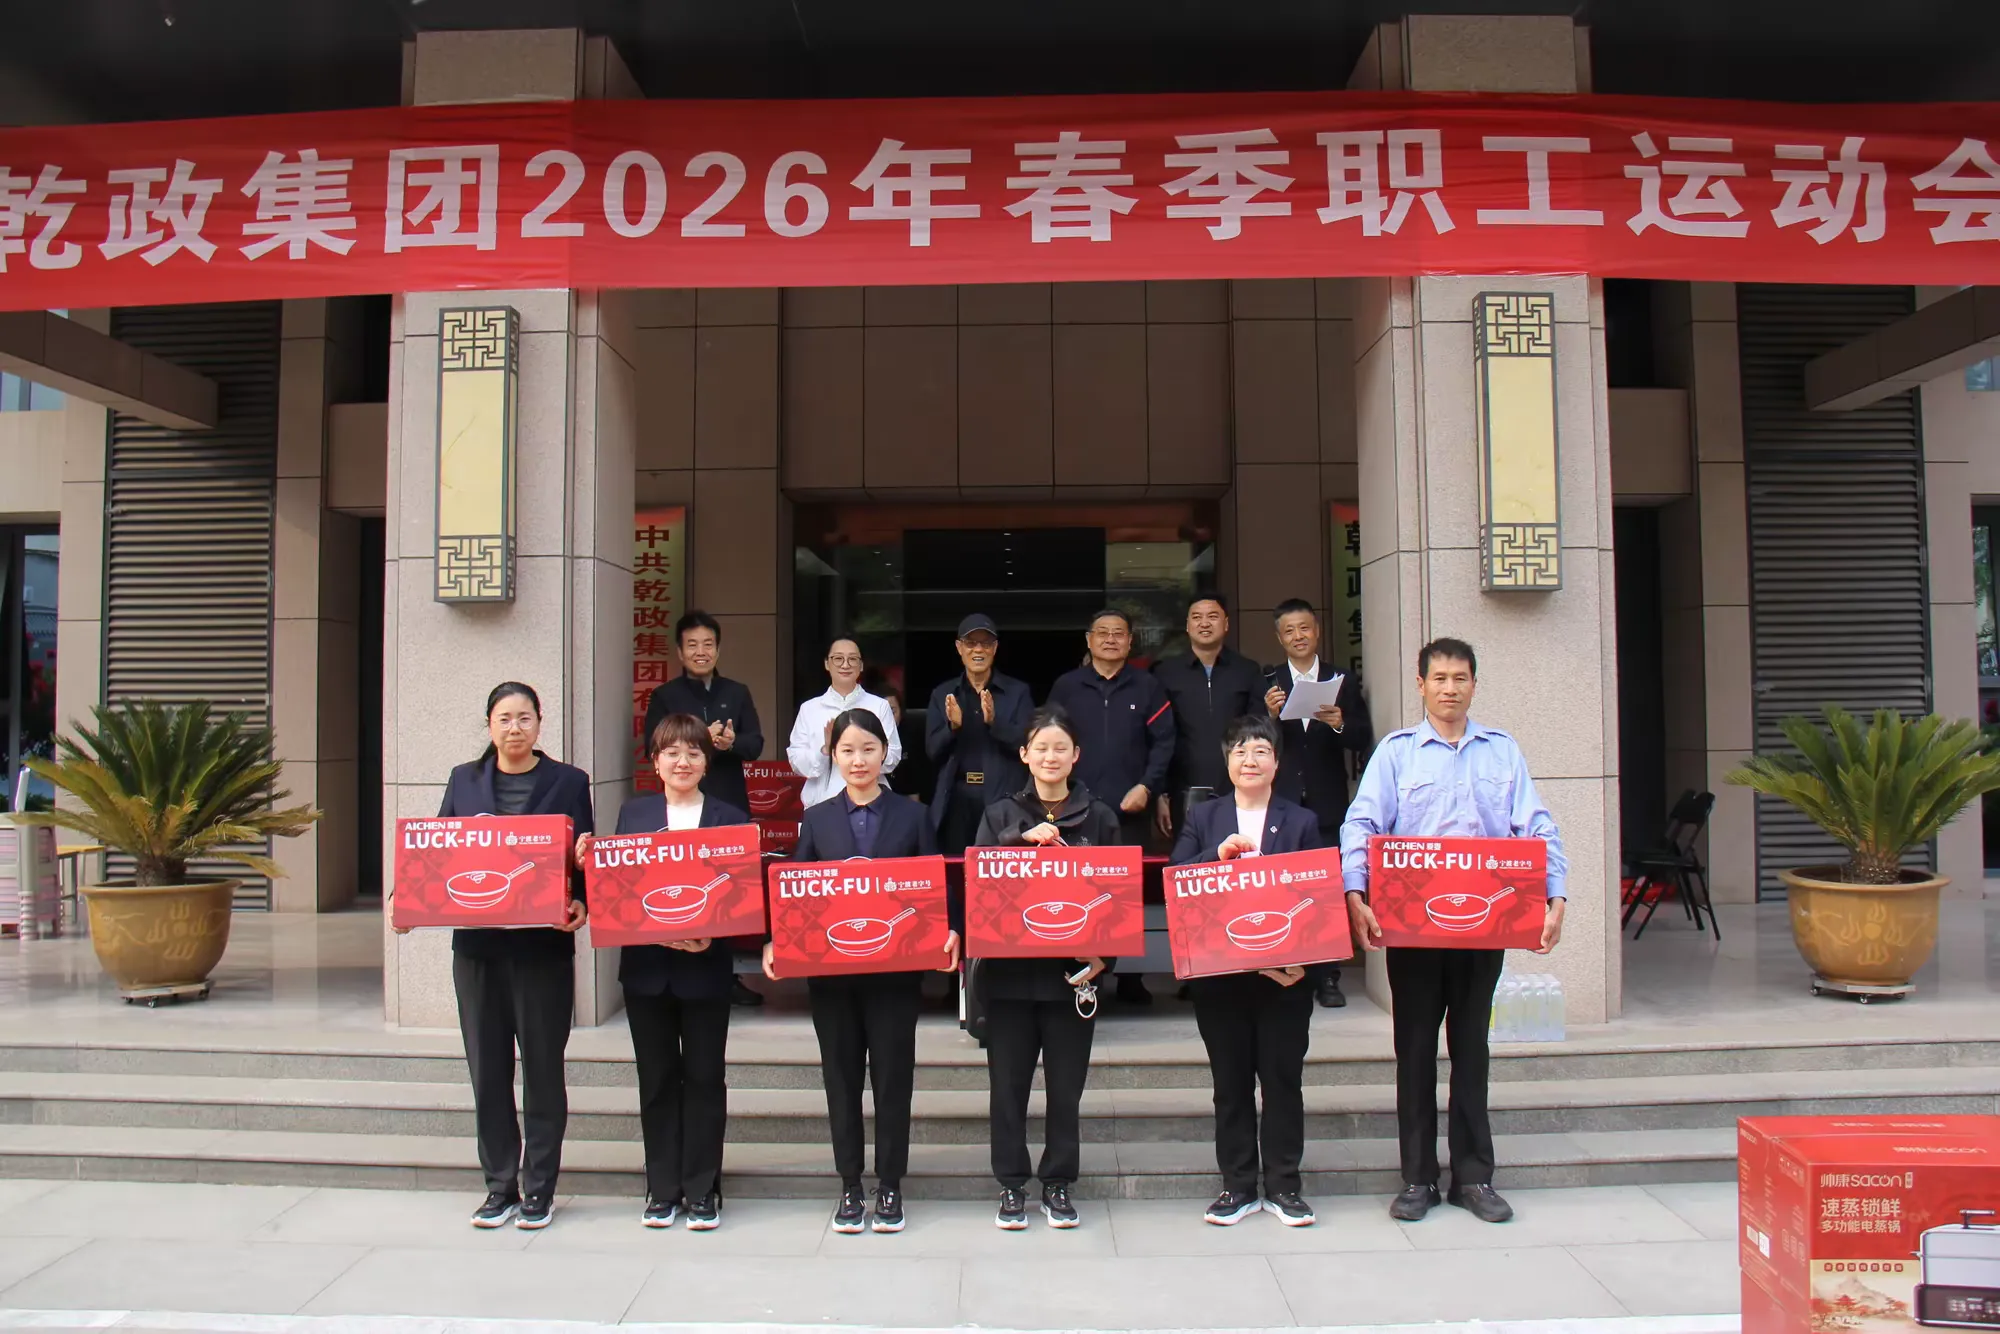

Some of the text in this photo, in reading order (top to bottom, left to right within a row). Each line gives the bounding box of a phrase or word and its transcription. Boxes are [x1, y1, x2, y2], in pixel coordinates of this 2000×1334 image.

[0, 129, 2000, 270] 乾政集团2026年春季职工运动会
[405, 821, 445, 831] AICHEN
[405, 830, 492, 849] LUCK-FU
[593, 839, 635, 850] AICHEN
[1382, 841, 1425, 850] AICHEN
[594, 844, 684, 868] LUCK-FU
[978, 851, 1020, 859] AICHEN
[1382, 851, 1472, 870] LUCK-FU
[779, 870, 821, 880] AICHEN
[978, 860, 1068, 878] LUCK-FU
[1174, 867, 1216, 879] AICHEN
[780, 877, 870, 898] LUCK-FU
[1175, 870, 1266, 898] LUCK-FU
[1821, 1198, 1901, 1217] 速蒸锁鲜
[1821, 1219, 1901, 1233] 多功能电蒸锅
